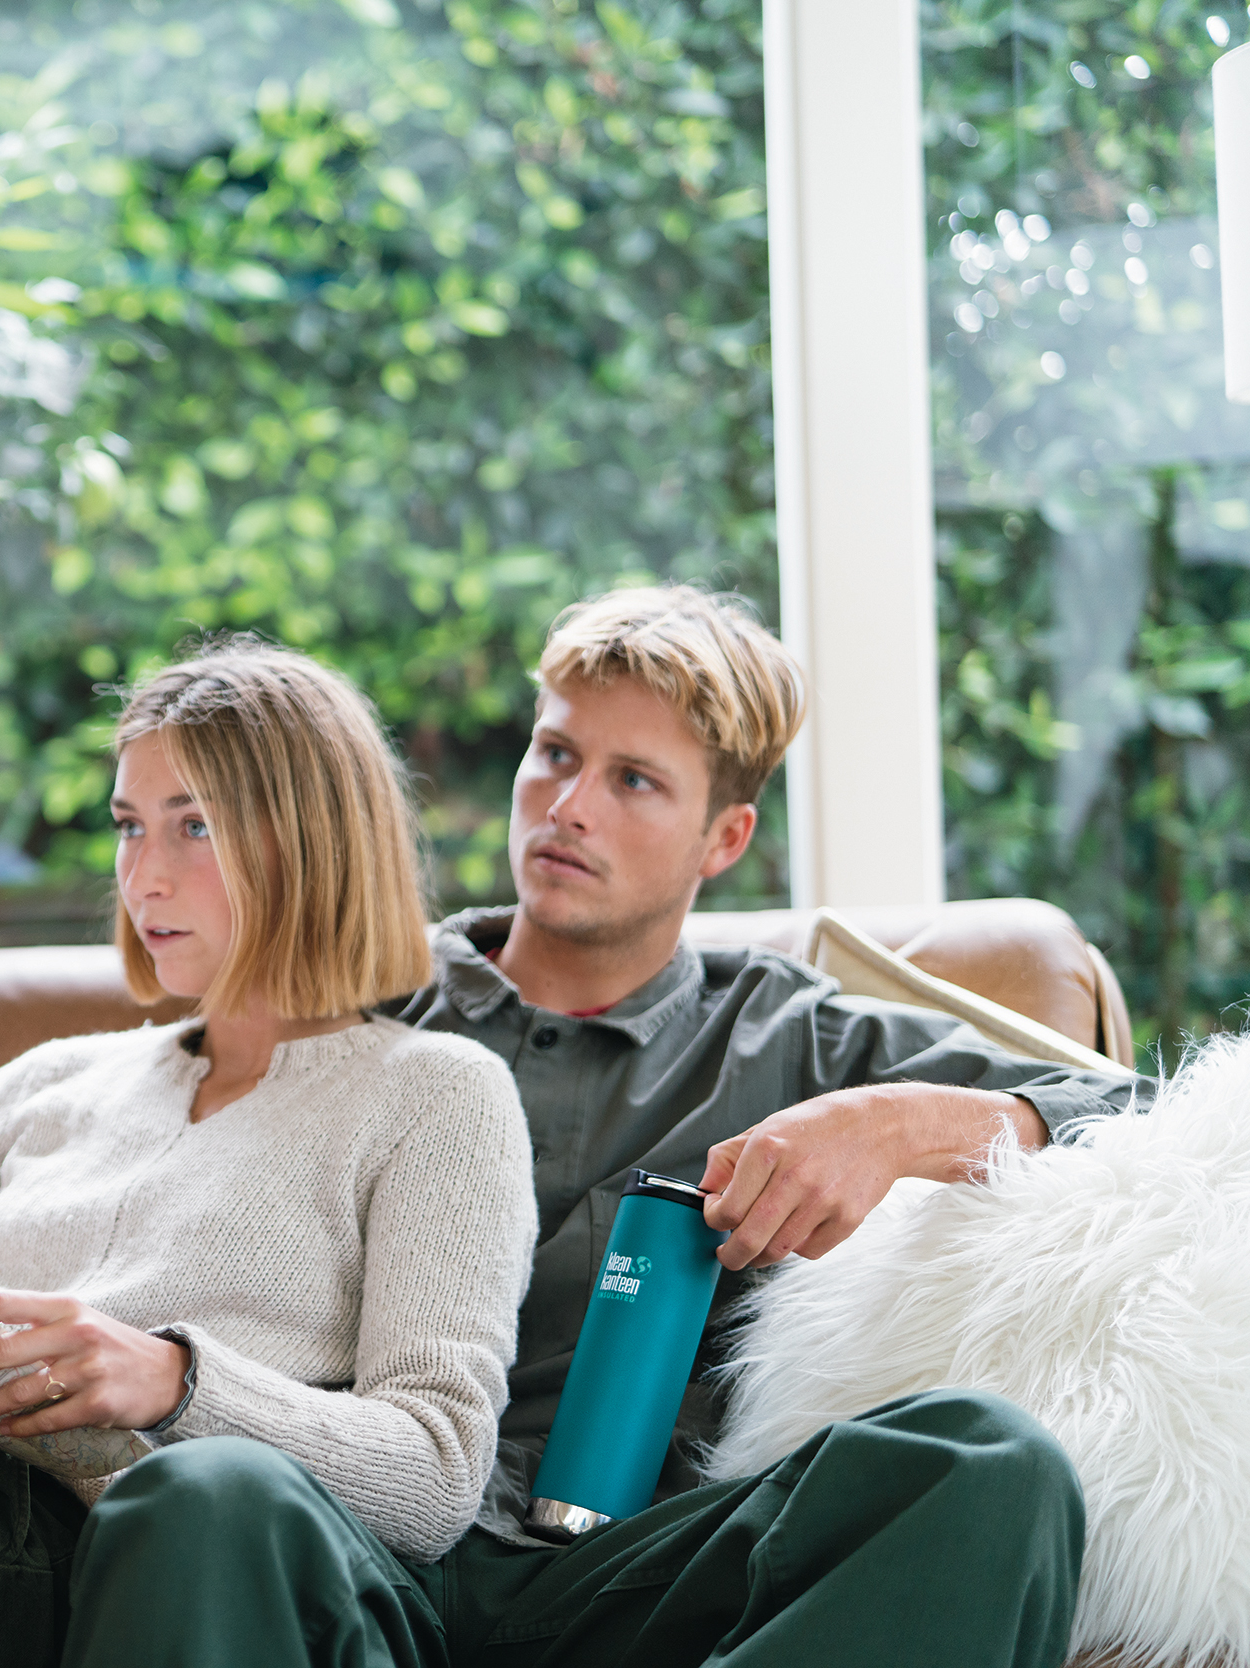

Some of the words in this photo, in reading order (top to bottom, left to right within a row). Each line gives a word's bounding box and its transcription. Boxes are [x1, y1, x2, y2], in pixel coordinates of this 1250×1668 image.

[606, 1251, 632, 1273] klean
[600, 1270, 641, 1296] kanteen
[597, 1291, 636, 1303] INSULATED
